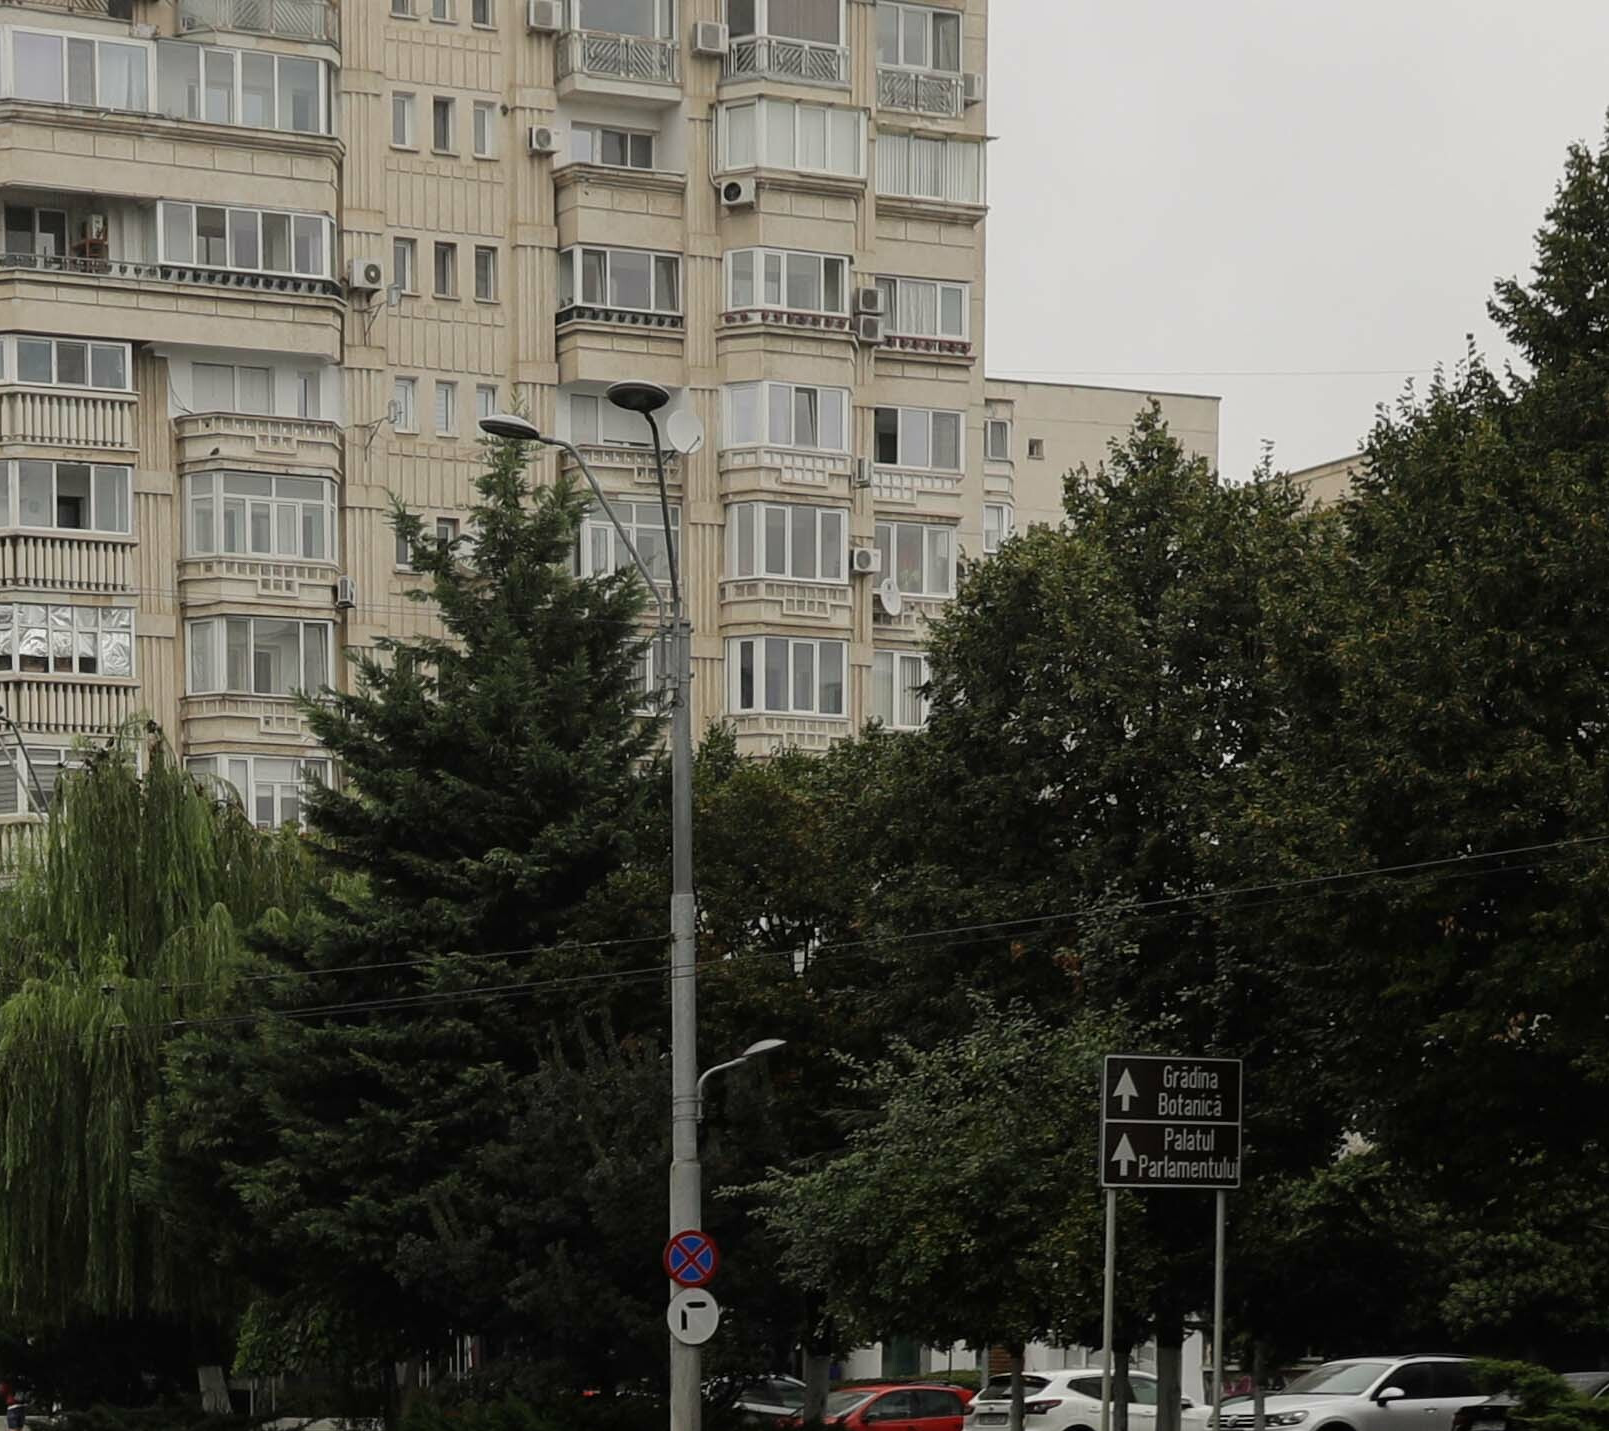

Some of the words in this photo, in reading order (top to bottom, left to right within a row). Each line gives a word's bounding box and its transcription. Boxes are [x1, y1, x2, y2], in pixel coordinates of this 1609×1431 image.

[1163, 1064, 1219, 1089] Grădina
[1157, 1091, 1223, 1117] Botanică
[1163, 1127, 1216, 1152] Palatul
[1138, 1154, 1240, 1179] Parlamentului
